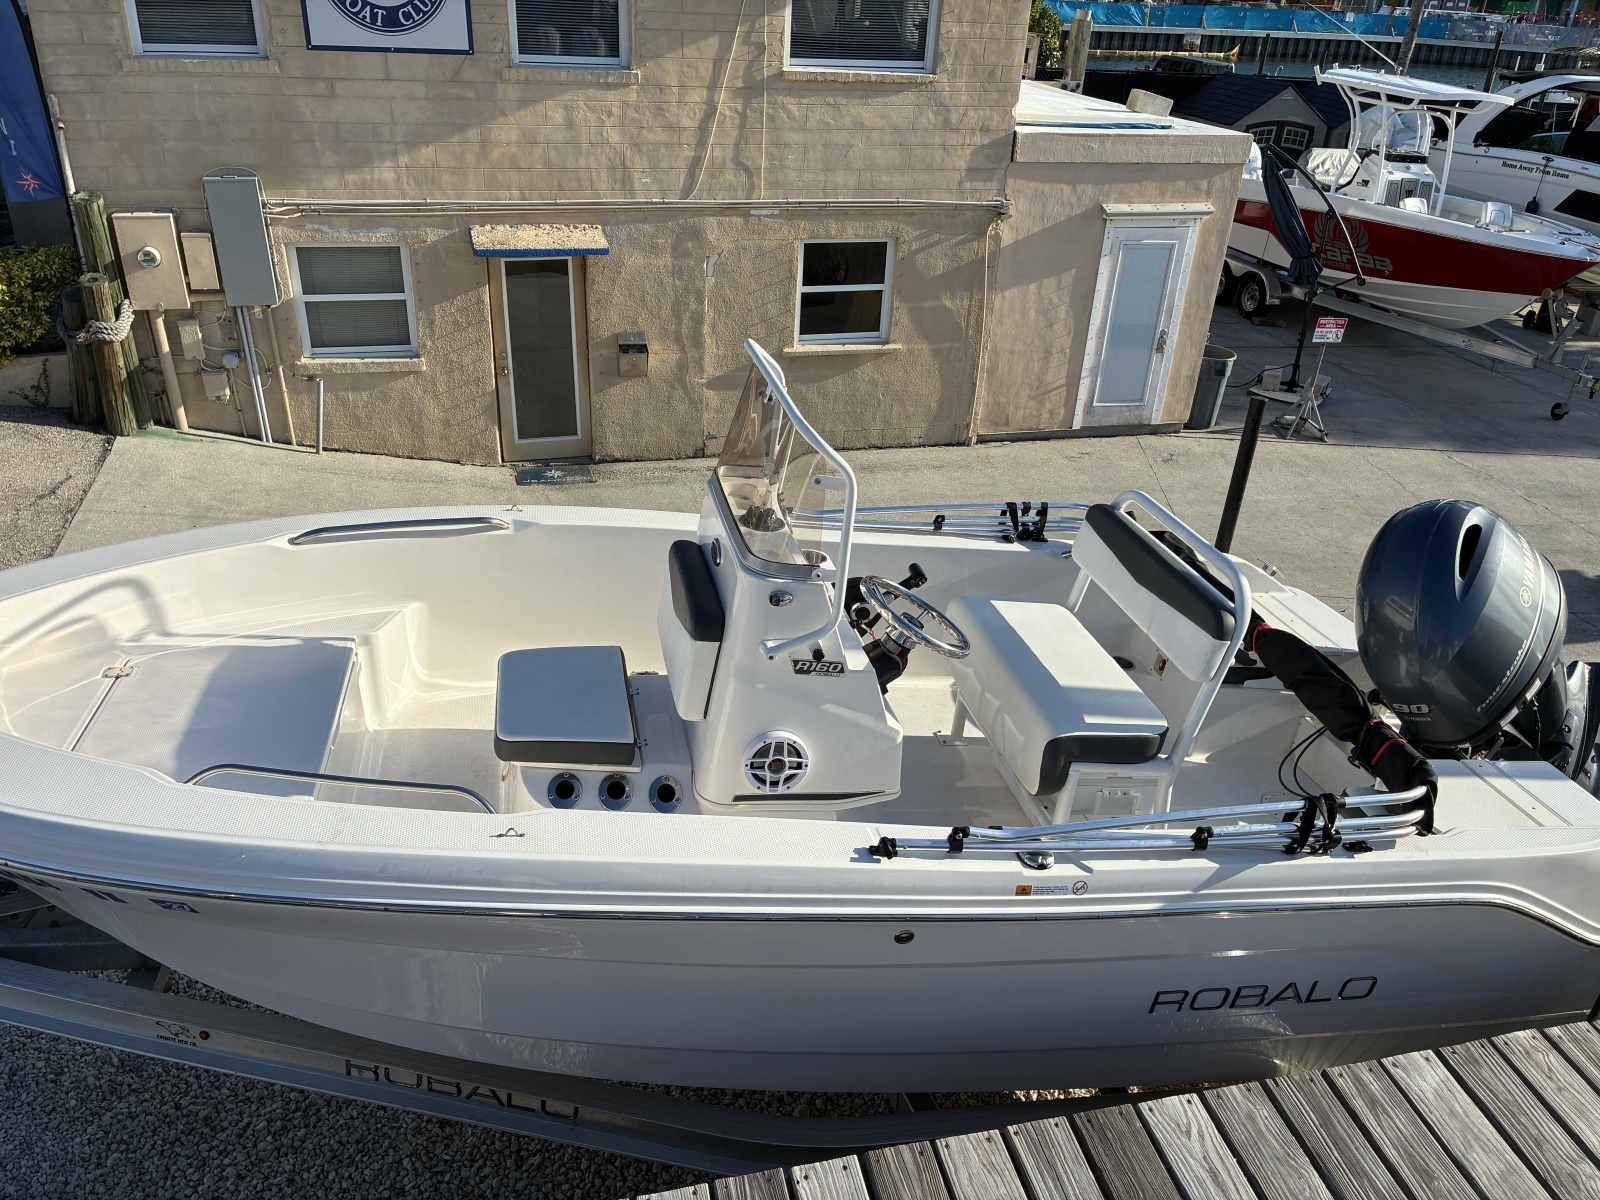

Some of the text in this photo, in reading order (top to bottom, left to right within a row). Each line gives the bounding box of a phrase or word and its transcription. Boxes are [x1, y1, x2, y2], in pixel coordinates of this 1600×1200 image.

[345, 0, 435, 27] OAT CLU
[1501, 161, 1570, 179] Home Away From Home
[795, 661, 843, 674] R160
[1392, 703, 1430, 714] 90
[1148, 975, 1378, 1015] ROBALO
